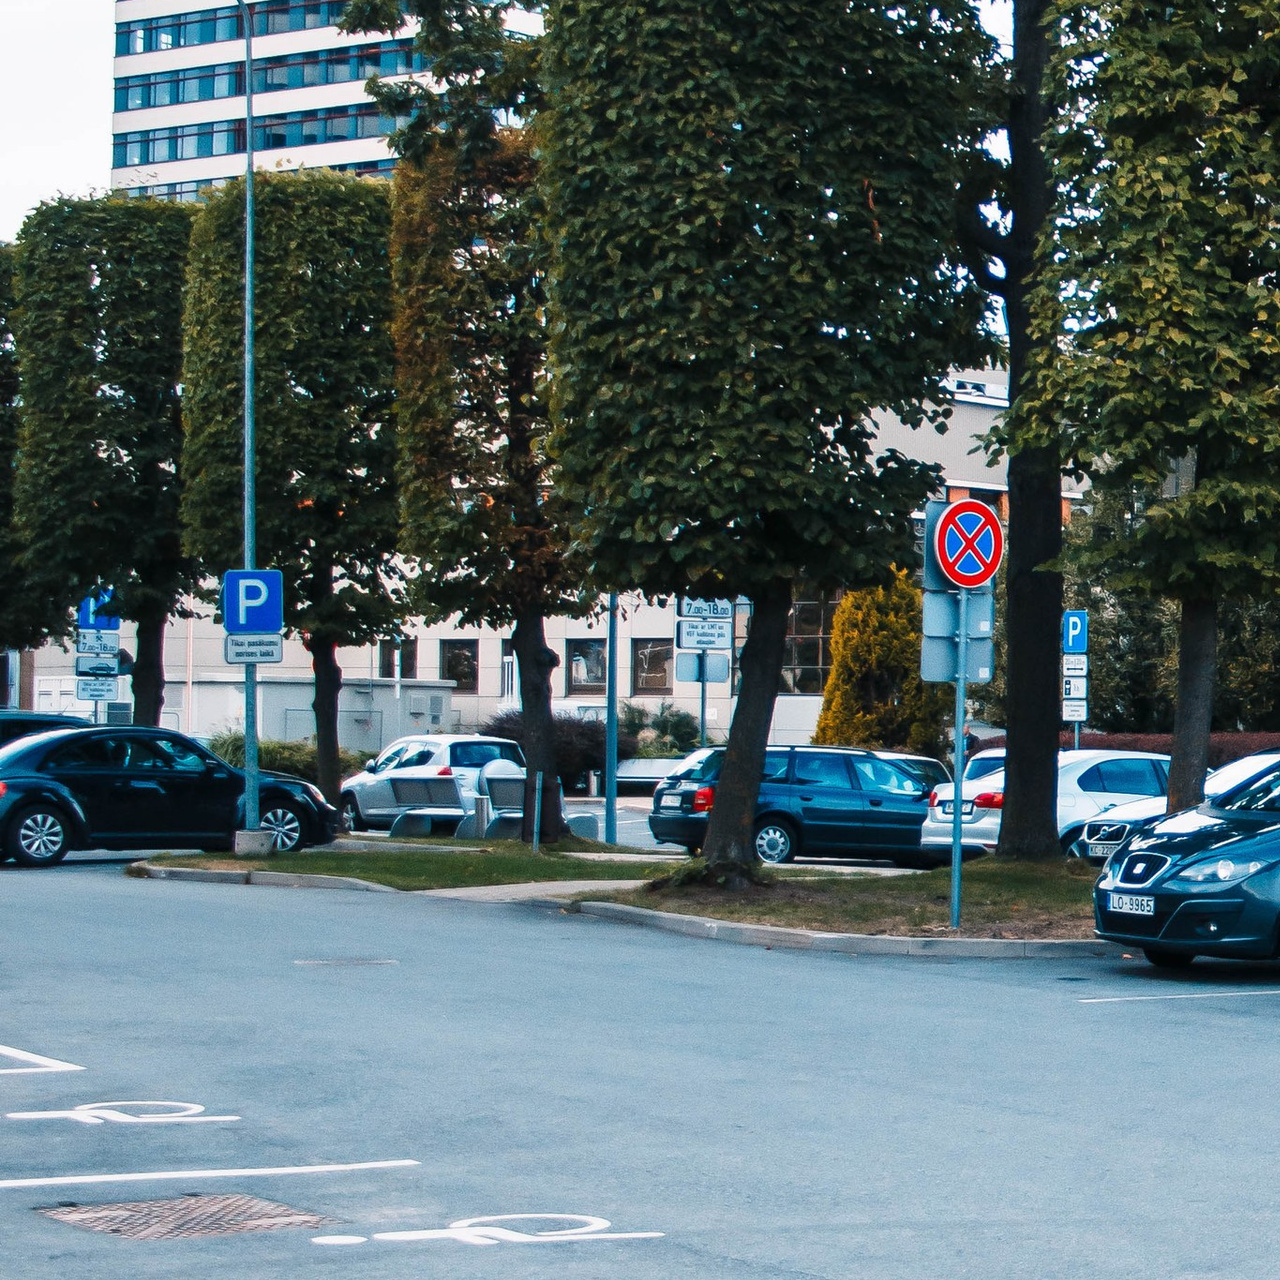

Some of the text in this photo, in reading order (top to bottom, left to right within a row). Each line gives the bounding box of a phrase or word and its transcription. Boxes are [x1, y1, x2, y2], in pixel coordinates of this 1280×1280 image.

[239, 578, 269, 624] P
[1069, 616, 1081, 647] P
[1112, 896, 1153, 913] LO-9965
